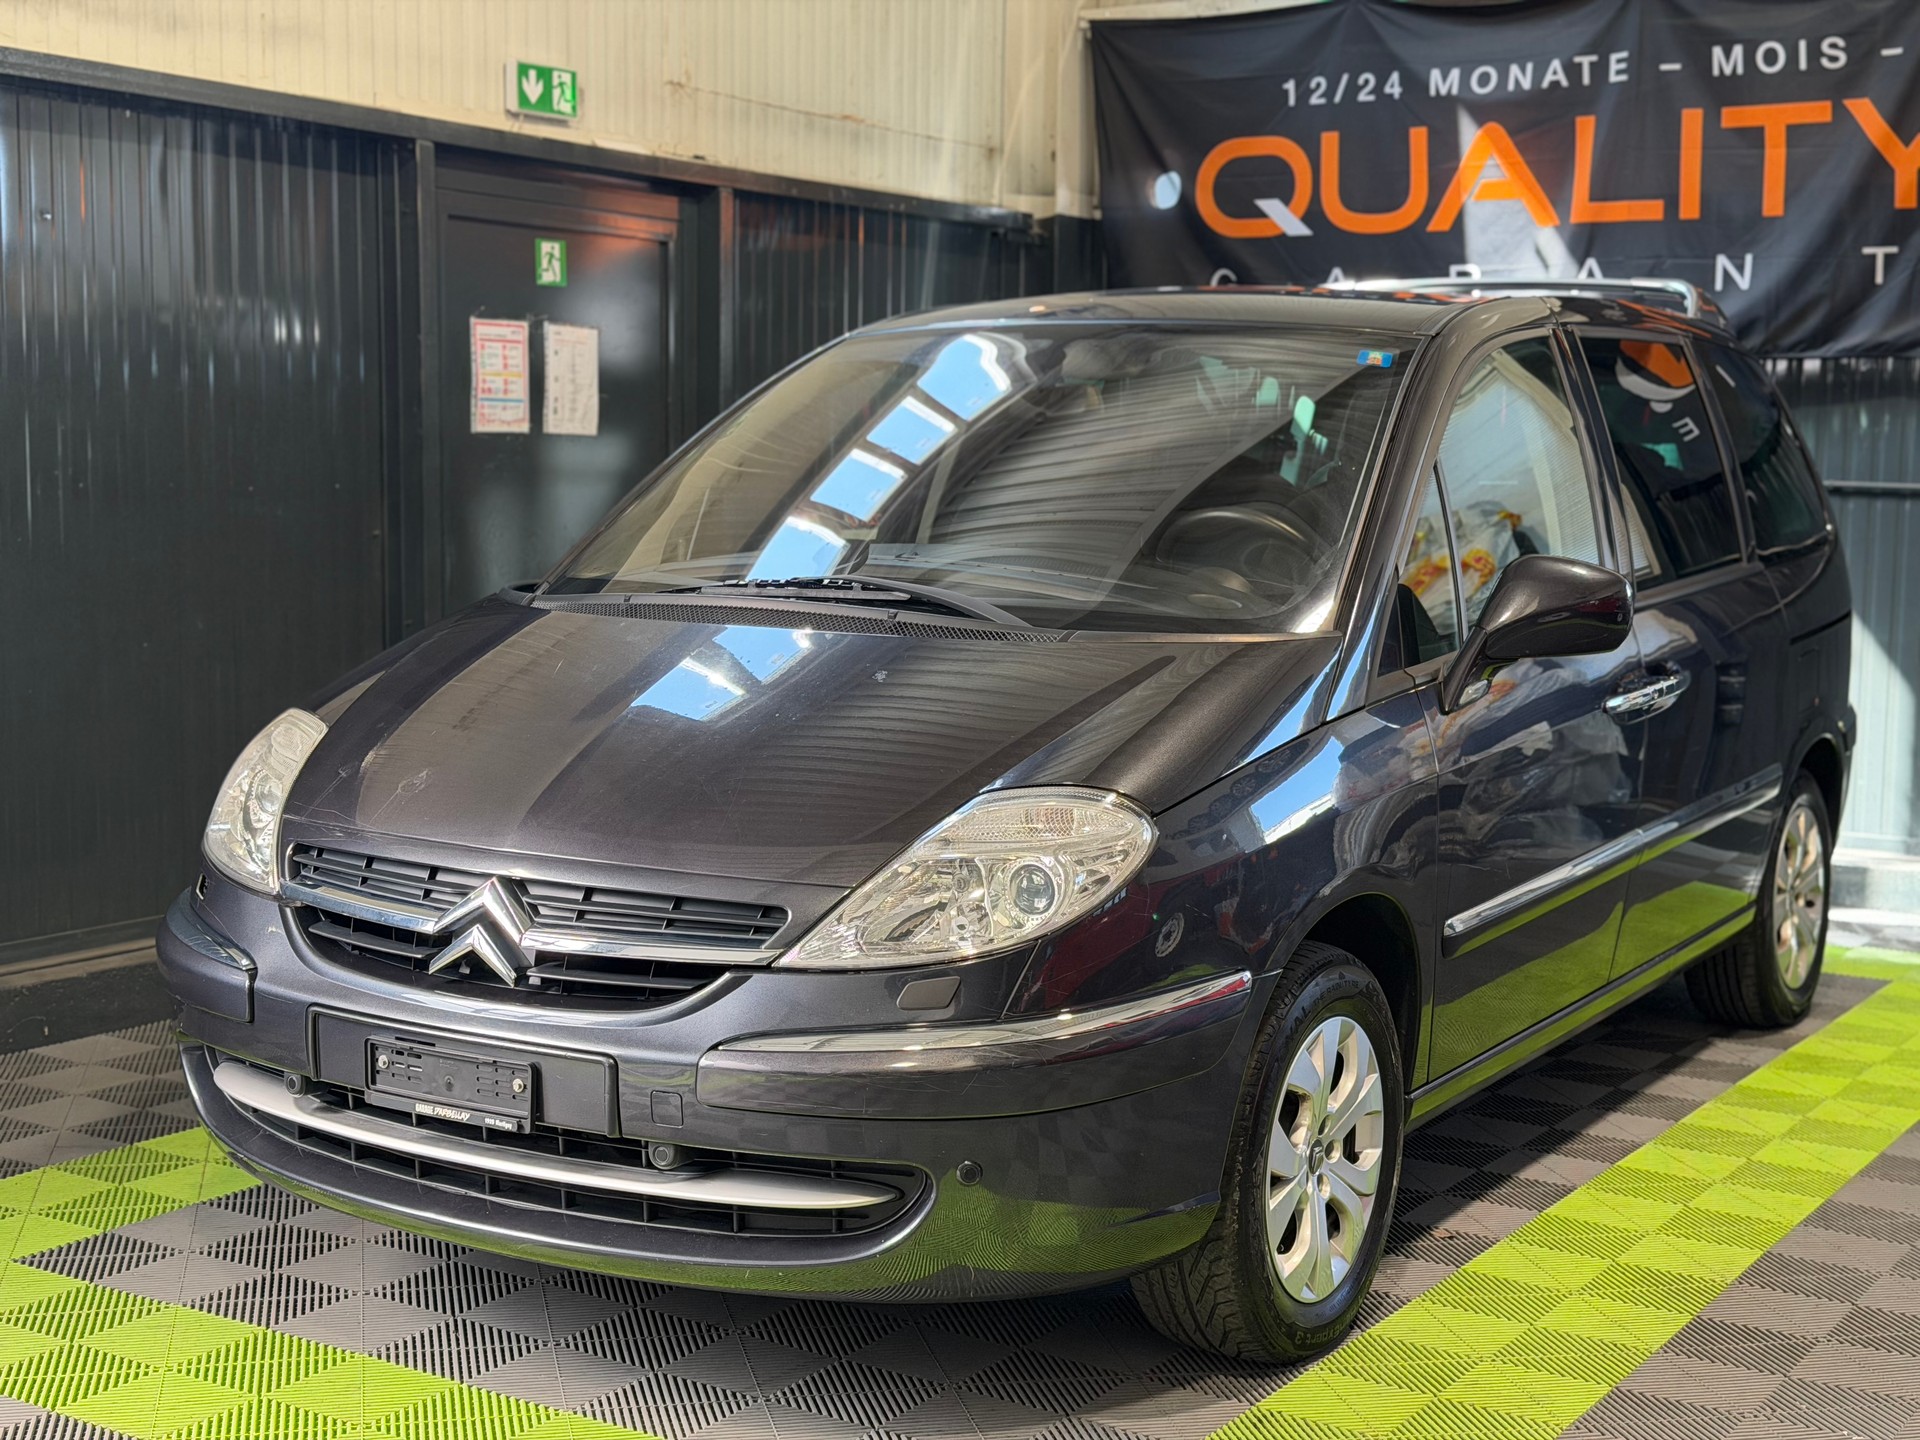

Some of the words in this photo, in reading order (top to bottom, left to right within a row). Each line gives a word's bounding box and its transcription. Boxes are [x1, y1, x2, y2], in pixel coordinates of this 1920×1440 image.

[1281, 70, 1404, 107] 12/24
[1429, 50, 1630, 97] MONATE
[1711, 36, 1848, 77] MOIS
[1194, 98, 1920, 239] QUALITY
